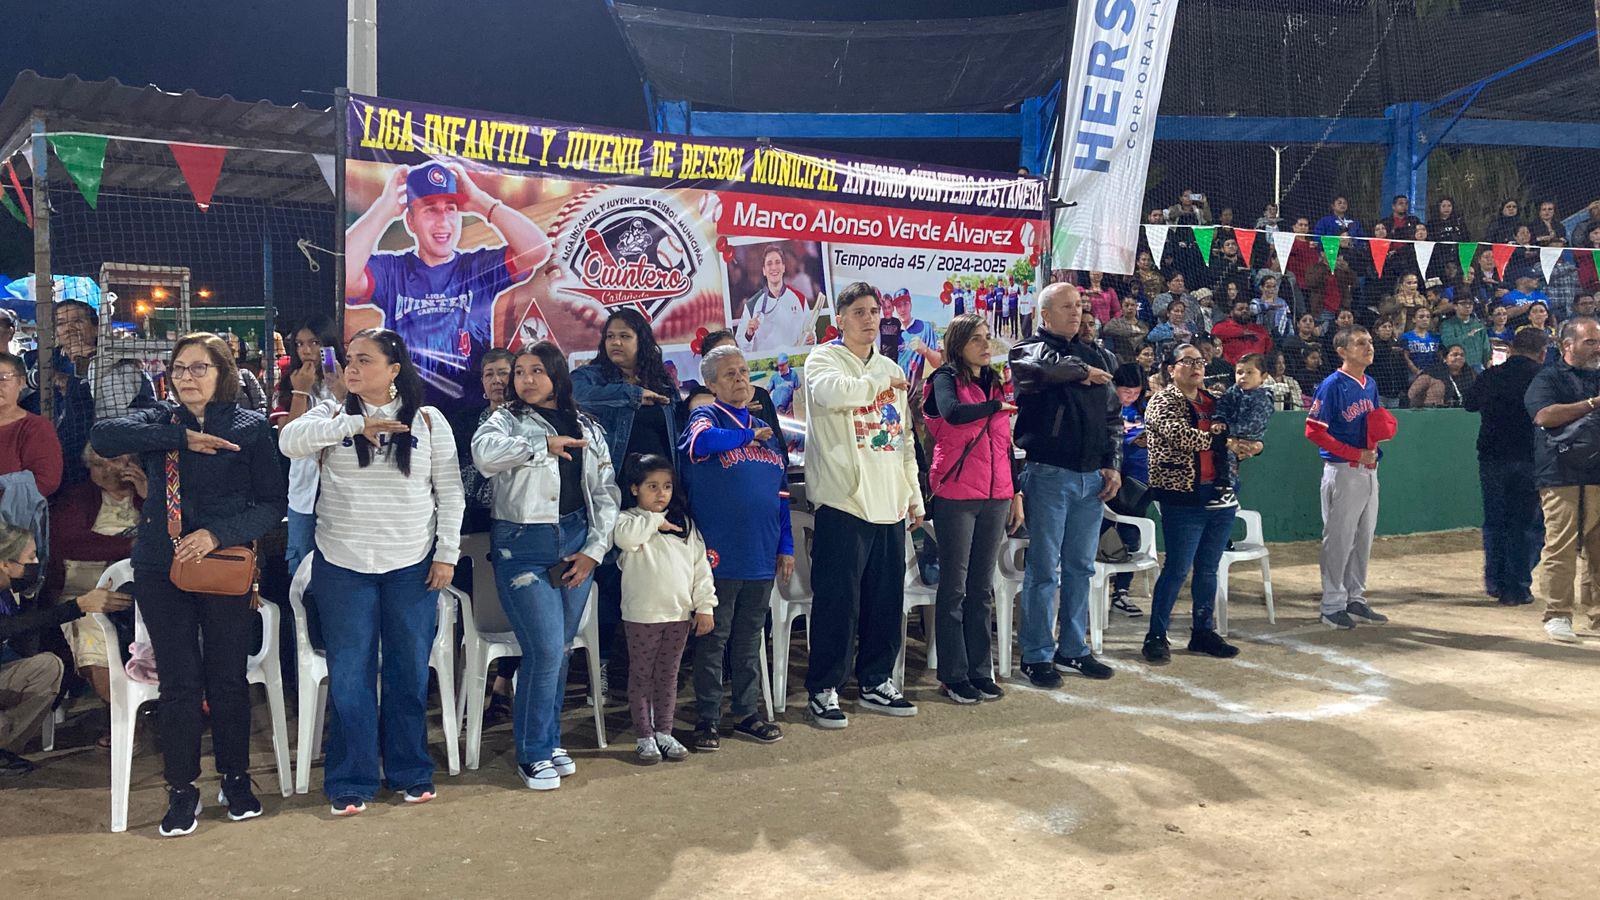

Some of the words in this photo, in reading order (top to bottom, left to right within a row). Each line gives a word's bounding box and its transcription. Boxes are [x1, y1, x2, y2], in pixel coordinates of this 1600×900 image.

[1073, 0, 1136, 173] HERS
[360, 105, 414, 152] LIGA
[422, 113, 530, 165] INFANTIL
[539, 127, 557, 167] Y
[558, 131, 644, 176] JUVENIL
[651, 140, 676, 178] DE
[678, 143, 746, 182] BEISBOL
[751, 149, 838, 192] MUNICIPAL
[842, 161, 907, 199] ANTONIO
[606, 196, 637, 209] JUVENIL
[639, 198, 652, 206] DE
[733, 201, 807, 232] Marco
[810, 208, 883, 238] Alonso
[887, 215, 941, 241] Verde
[943, 216, 1014, 246] Álvarez
[582, 251, 689, 289] Quintero
[834, 249, 905, 271] Temporada
[907, 254, 926, 270] 45
[937, 256, 1007, 273] 2024-2025
